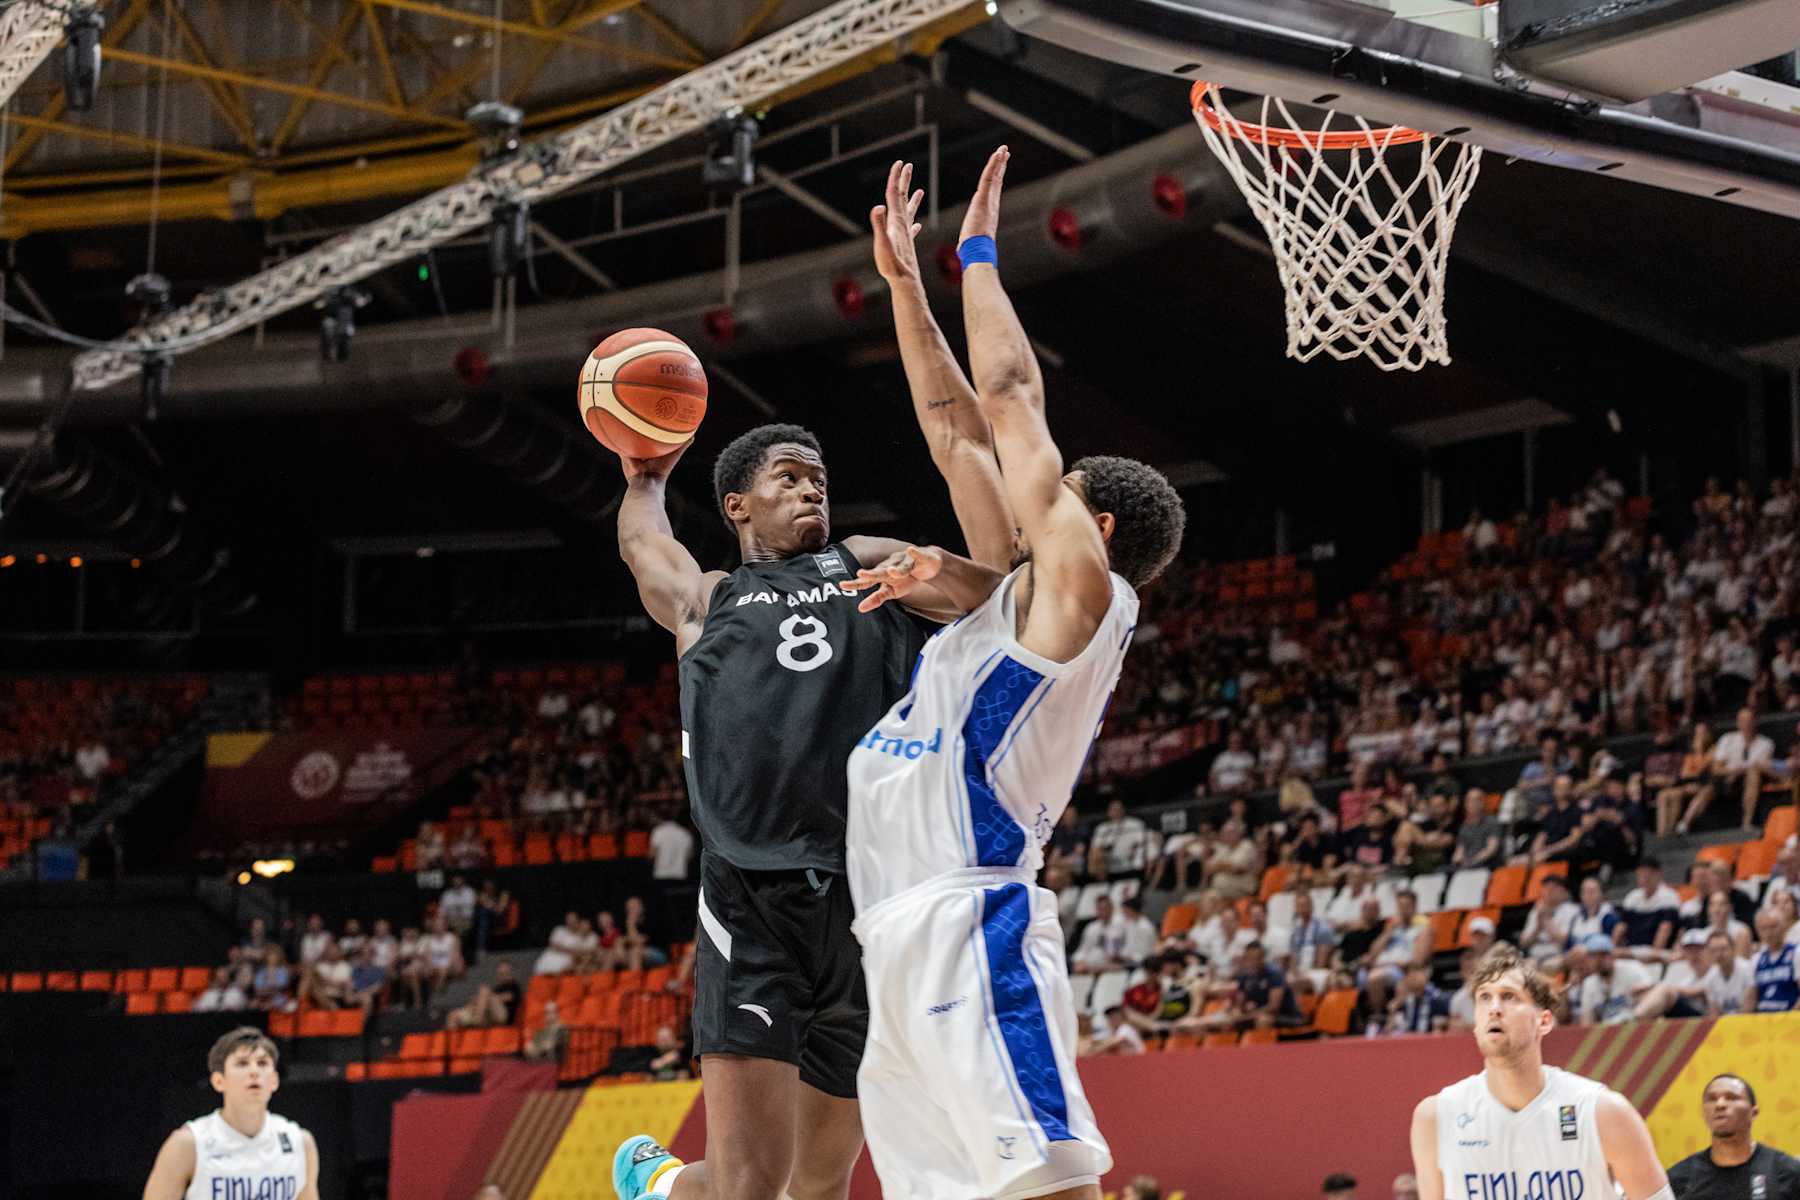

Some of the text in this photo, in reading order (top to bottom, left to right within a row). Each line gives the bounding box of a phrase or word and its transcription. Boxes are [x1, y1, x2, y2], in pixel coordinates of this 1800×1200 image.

[776, 613, 833, 672] 8
[211, 1175, 297, 1200] FINLAND
[1463, 1168, 1585, 1200] FINLAND
